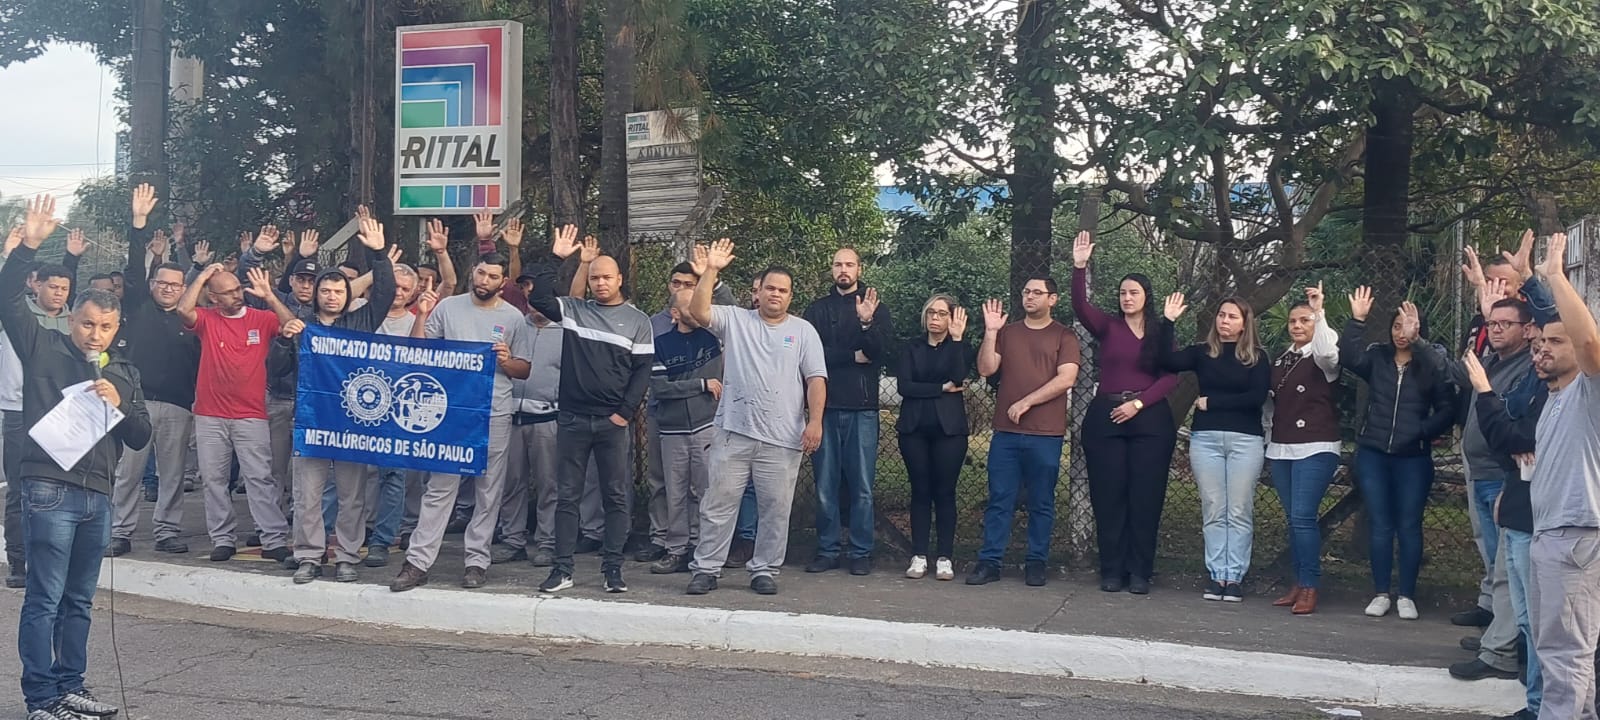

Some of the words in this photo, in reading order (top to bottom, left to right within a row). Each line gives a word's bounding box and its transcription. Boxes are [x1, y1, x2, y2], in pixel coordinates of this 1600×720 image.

[628, 122, 650, 132] RITTAL
[401, 134, 501, 169] RITTAL
[311, 336, 368, 359] SINDICATO
[368, 342, 392, 362] DOS
[394, 346, 484, 372] TRABALHADORES
[305, 429, 392, 454] METALÚRGICOS
[394, 440, 410, 456] DE
[413, 440, 436, 459] SÃO
[438, 445, 474, 463] PAULO
